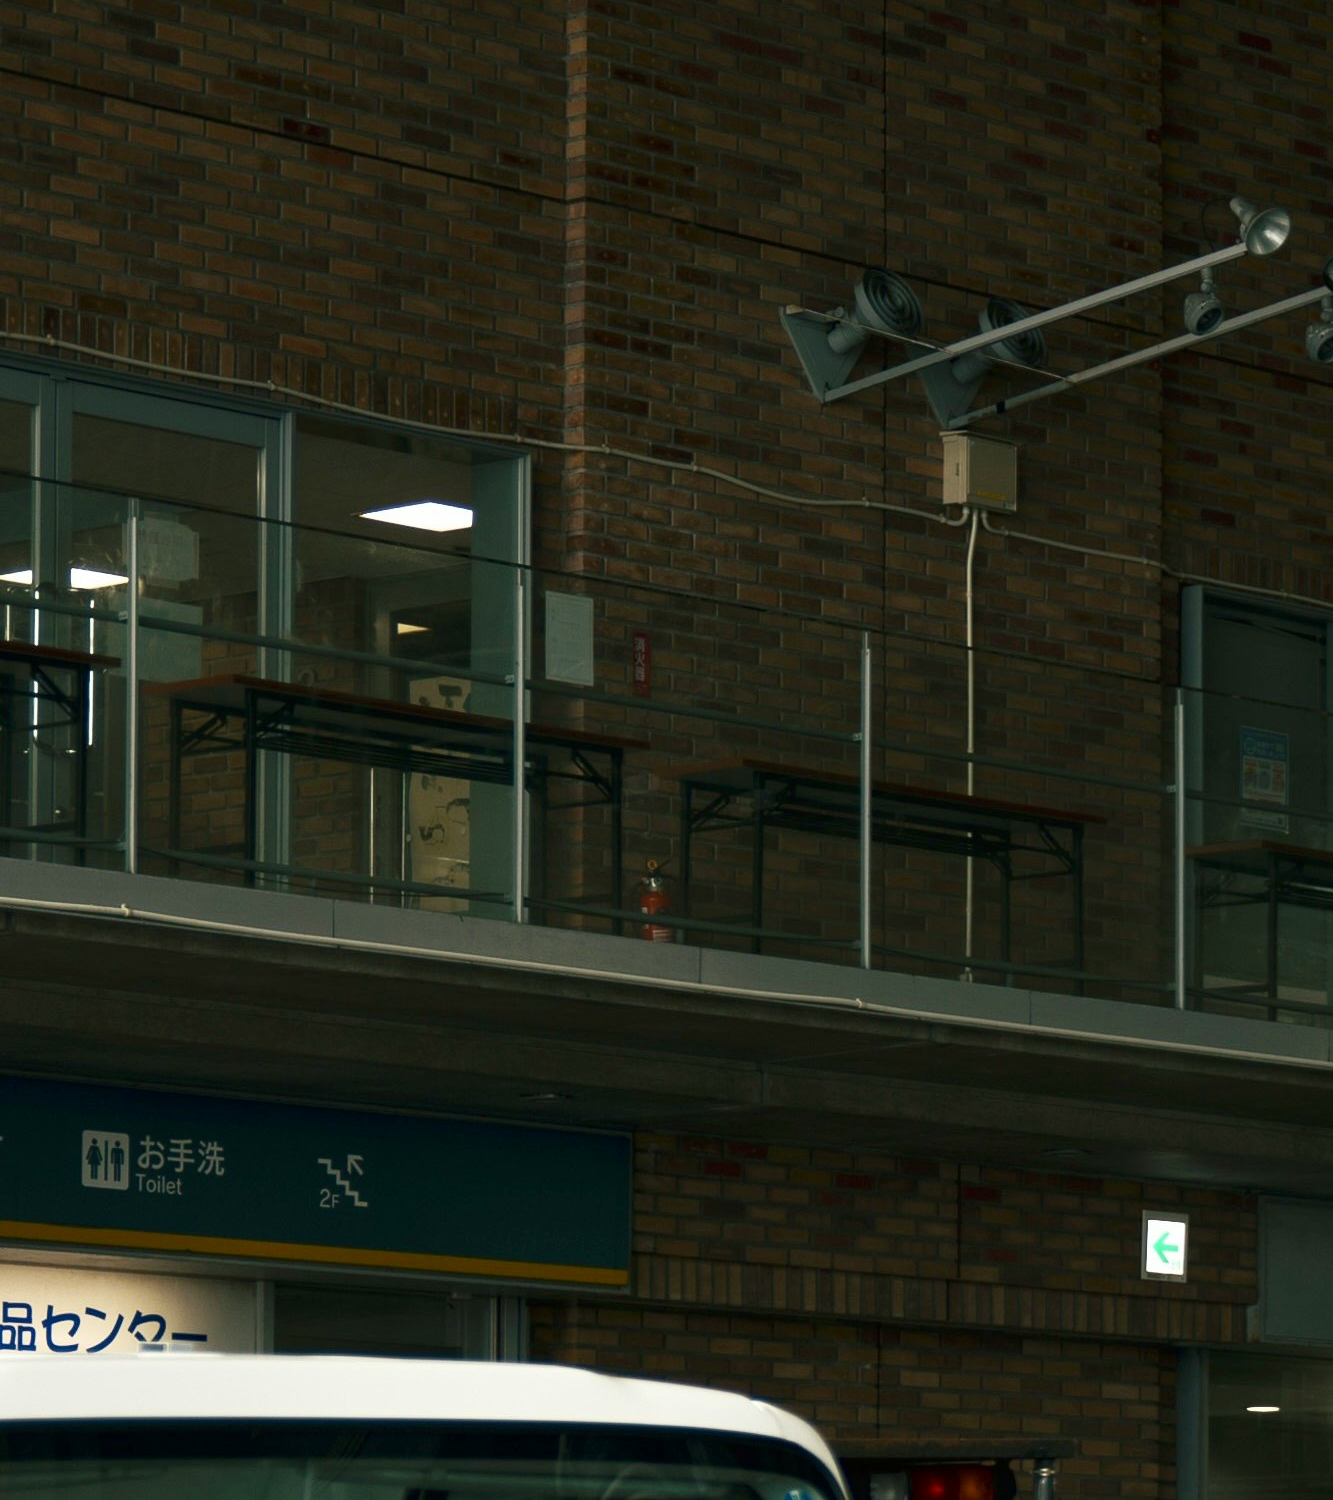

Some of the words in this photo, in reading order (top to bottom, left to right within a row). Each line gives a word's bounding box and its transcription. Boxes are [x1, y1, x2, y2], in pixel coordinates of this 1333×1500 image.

[136, 1134, 226, 1177] お手洗
[135, 1173, 183, 1197] Toilet
[319, 1188, 340, 1209] 2F
